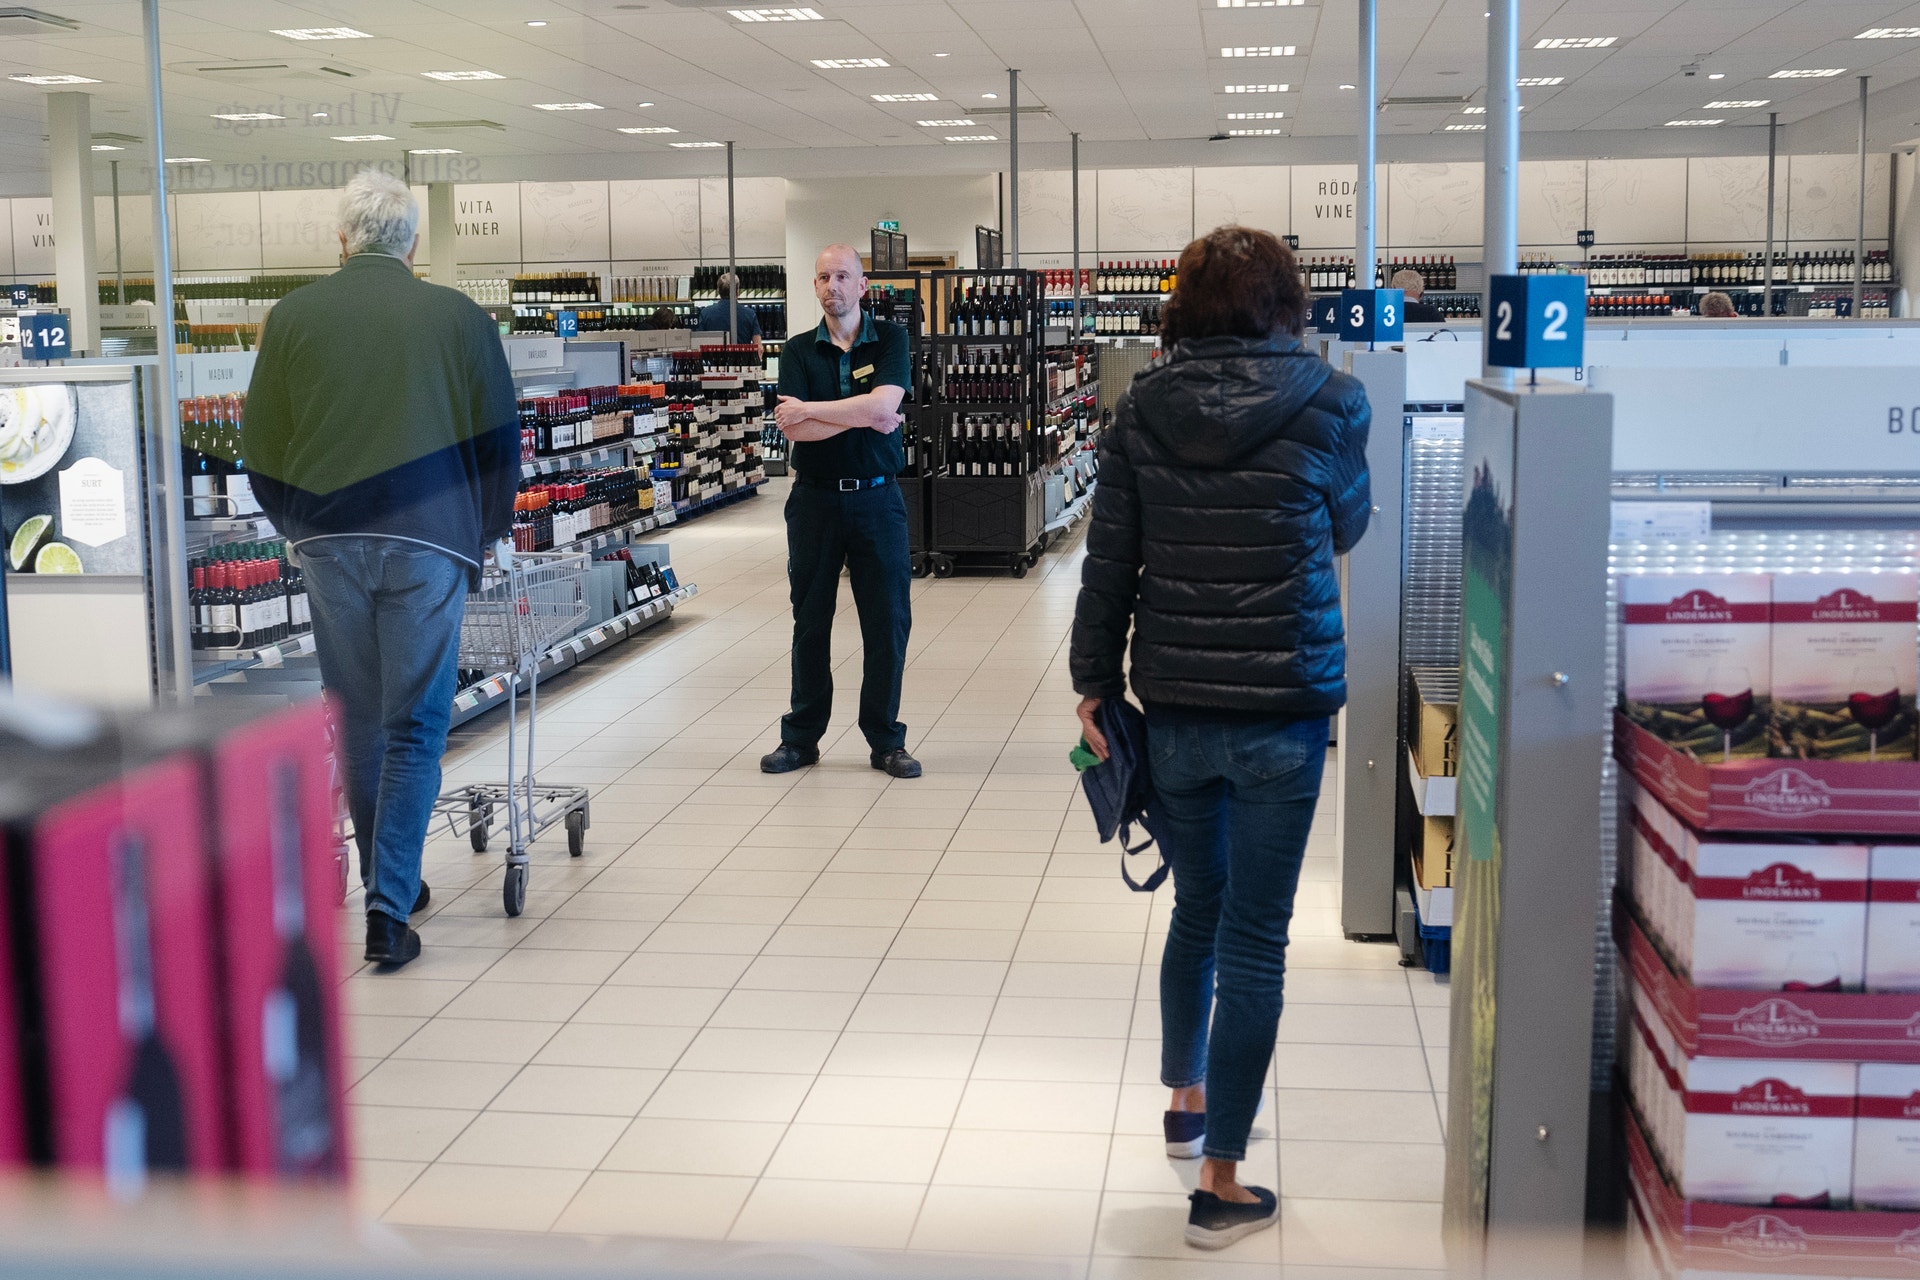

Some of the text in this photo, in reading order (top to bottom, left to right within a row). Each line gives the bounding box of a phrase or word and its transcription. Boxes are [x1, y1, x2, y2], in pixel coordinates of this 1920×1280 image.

[459, 200, 493, 214] VITA
[1315, 204, 1353, 219] VINE
[36, 213, 50, 226] VI
[454, 221, 500, 236] VINER
[32, 234, 55, 248] VIN
[1291, 238, 1298, 246] 10
[1586, 234, 1594, 242] 10
[12, 290, 27, 300] 15
[1840, 302, 1848, 311] 7
[1305, 308, 1313, 320] 5
[1325, 307, 1336, 324] 4
[1350, 304, 1396, 327] 3 3
[1496, 300, 1568, 341] 2 2
[560, 319, 576, 331] 12
[20, 327, 66, 348] 12 12
[208, 367, 234, 381] MAGNUM
[1888, 407, 1920, 435] BO
[81, 479, 102, 488] SURT
[1693, 593, 1706, 610] L
[1840, 592, 1852, 610] L
[1665, 609, 1733, 621] LINDEMAN'S
[1812, 608, 1880, 620] LINDEMAN'S
[1780, 772, 1794, 793] L
[1775, 867, 1789, 887] L
[1742, 886, 1821, 899] LINDEMAN'S
[1769, 1002, 1784, 1023] L
[1764, 1082, 1779, 1102] L
[1731, 1101, 1810, 1114] LINDEMAN'S
